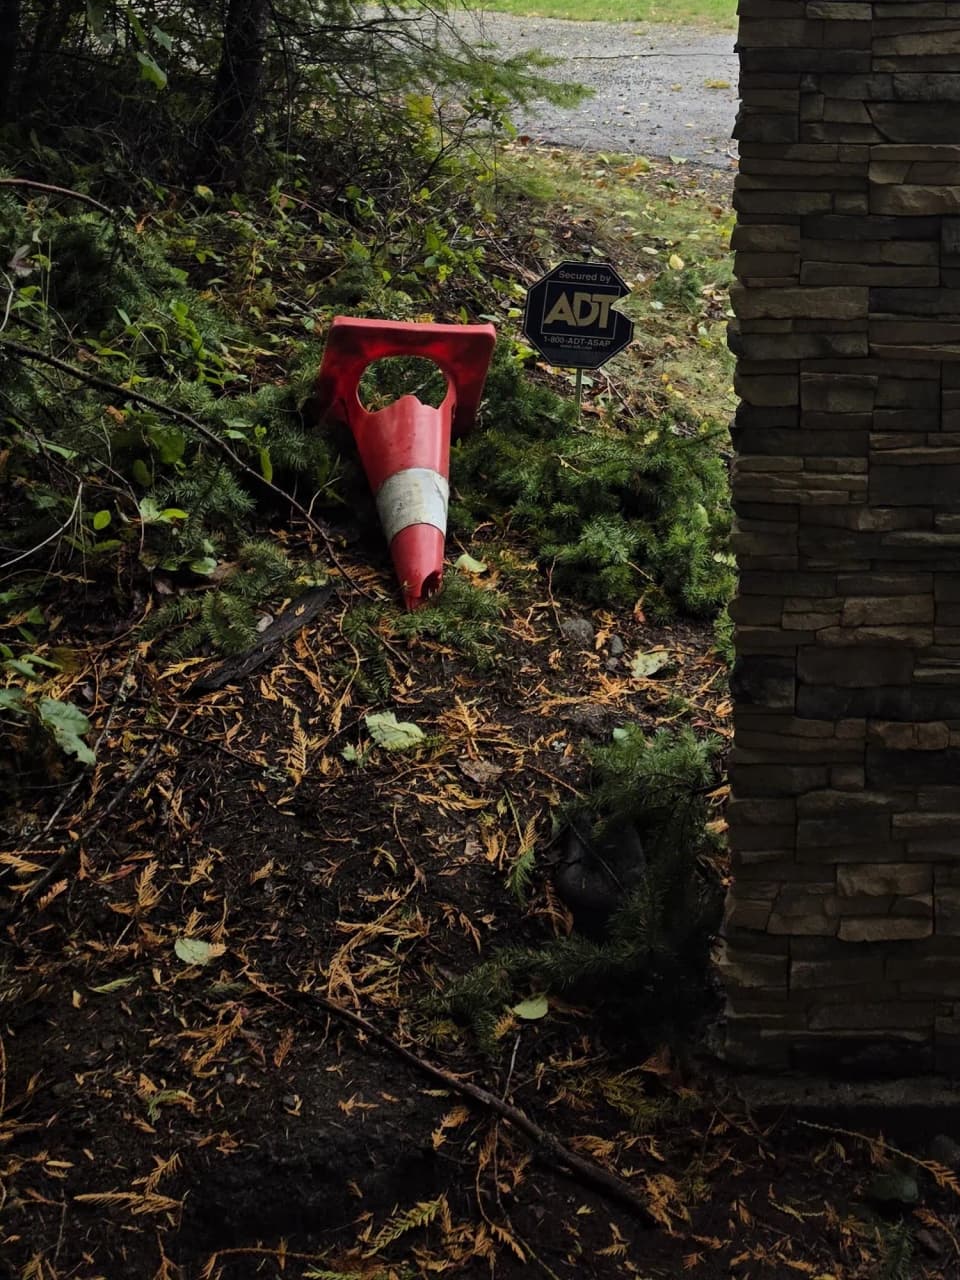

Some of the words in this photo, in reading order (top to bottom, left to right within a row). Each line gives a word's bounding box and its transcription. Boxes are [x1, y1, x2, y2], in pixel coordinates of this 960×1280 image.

[559, 271, 597, 281] Secured
[600, 275, 611, 283] by
[544, 291, 619, 328] ADT
[544, 336, 611, 347] 1-800-ADT-ASAP
